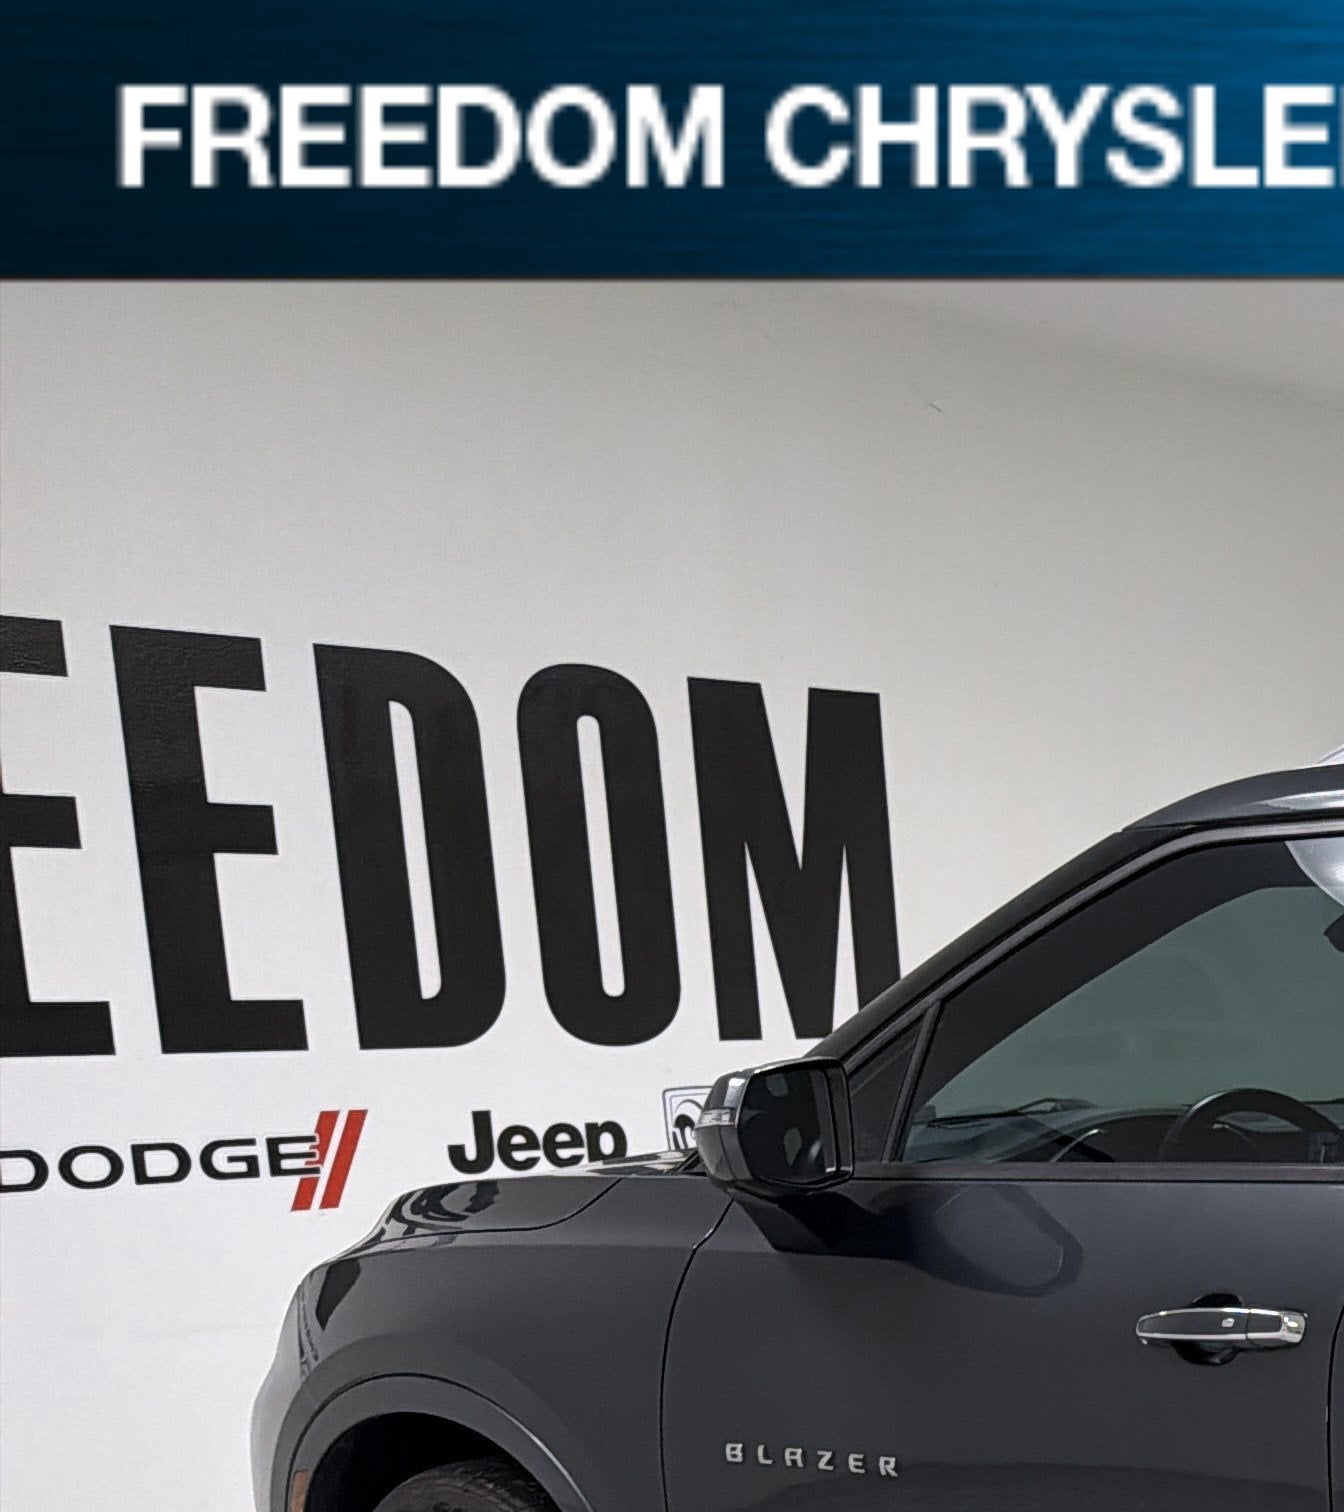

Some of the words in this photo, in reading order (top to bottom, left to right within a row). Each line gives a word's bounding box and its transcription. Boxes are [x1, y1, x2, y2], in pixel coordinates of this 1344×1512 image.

[0, 1134, 321, 1194] DODGE
[447, 1110, 628, 1175] Jeep
[725, 1443, 899, 1477] BLAZER
